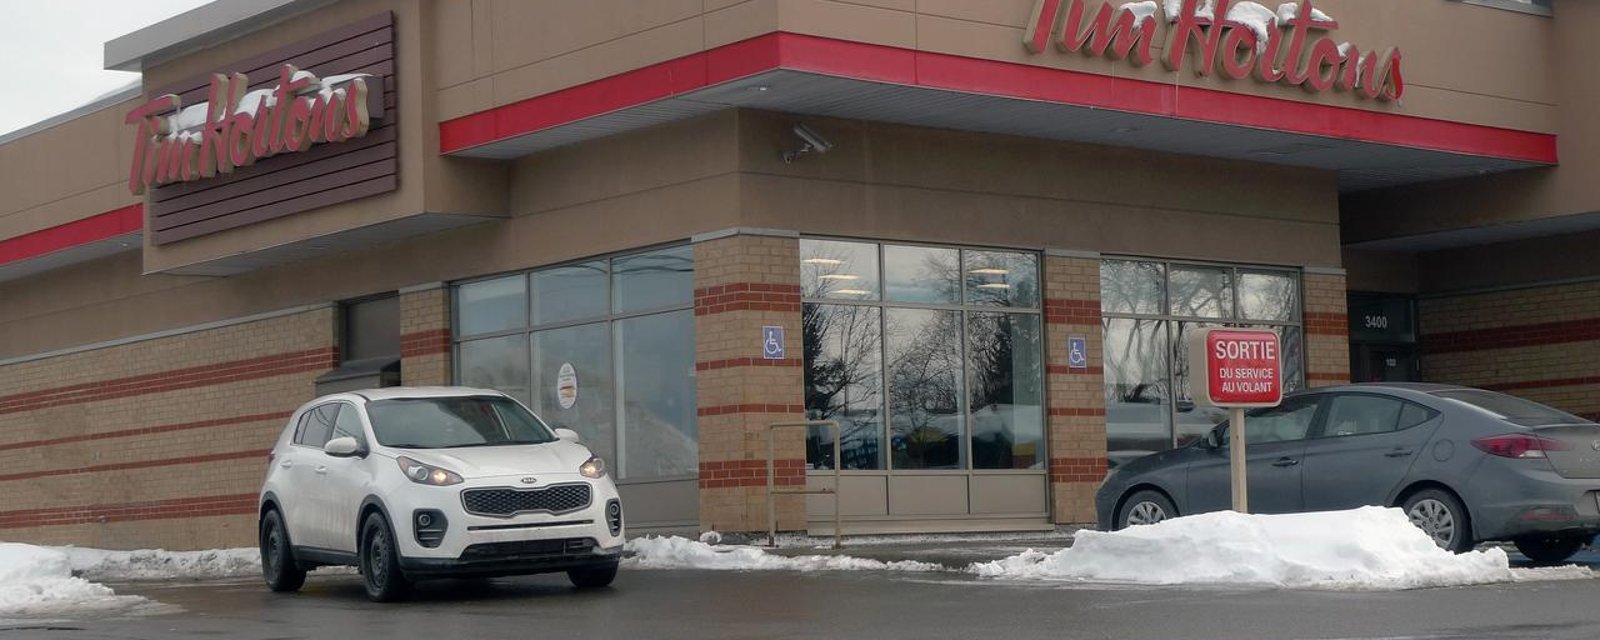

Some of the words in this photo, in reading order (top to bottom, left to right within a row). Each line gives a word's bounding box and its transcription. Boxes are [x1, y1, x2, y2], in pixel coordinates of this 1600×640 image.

[1161, 0, 1403, 100] Hortons
[125, 94, 203, 195] Tim
[201, 64, 369, 178] Hortons
[1365, 315, 1387, 329] 3400
[1215, 340, 1276, 360] SORTIE
[1219, 368, 1233, 379] DU
[1235, 368, 1274, 379] SERVICE
[1222, 382, 1235, 393] AU
[1236, 382, 1273, 393] VOLANT
